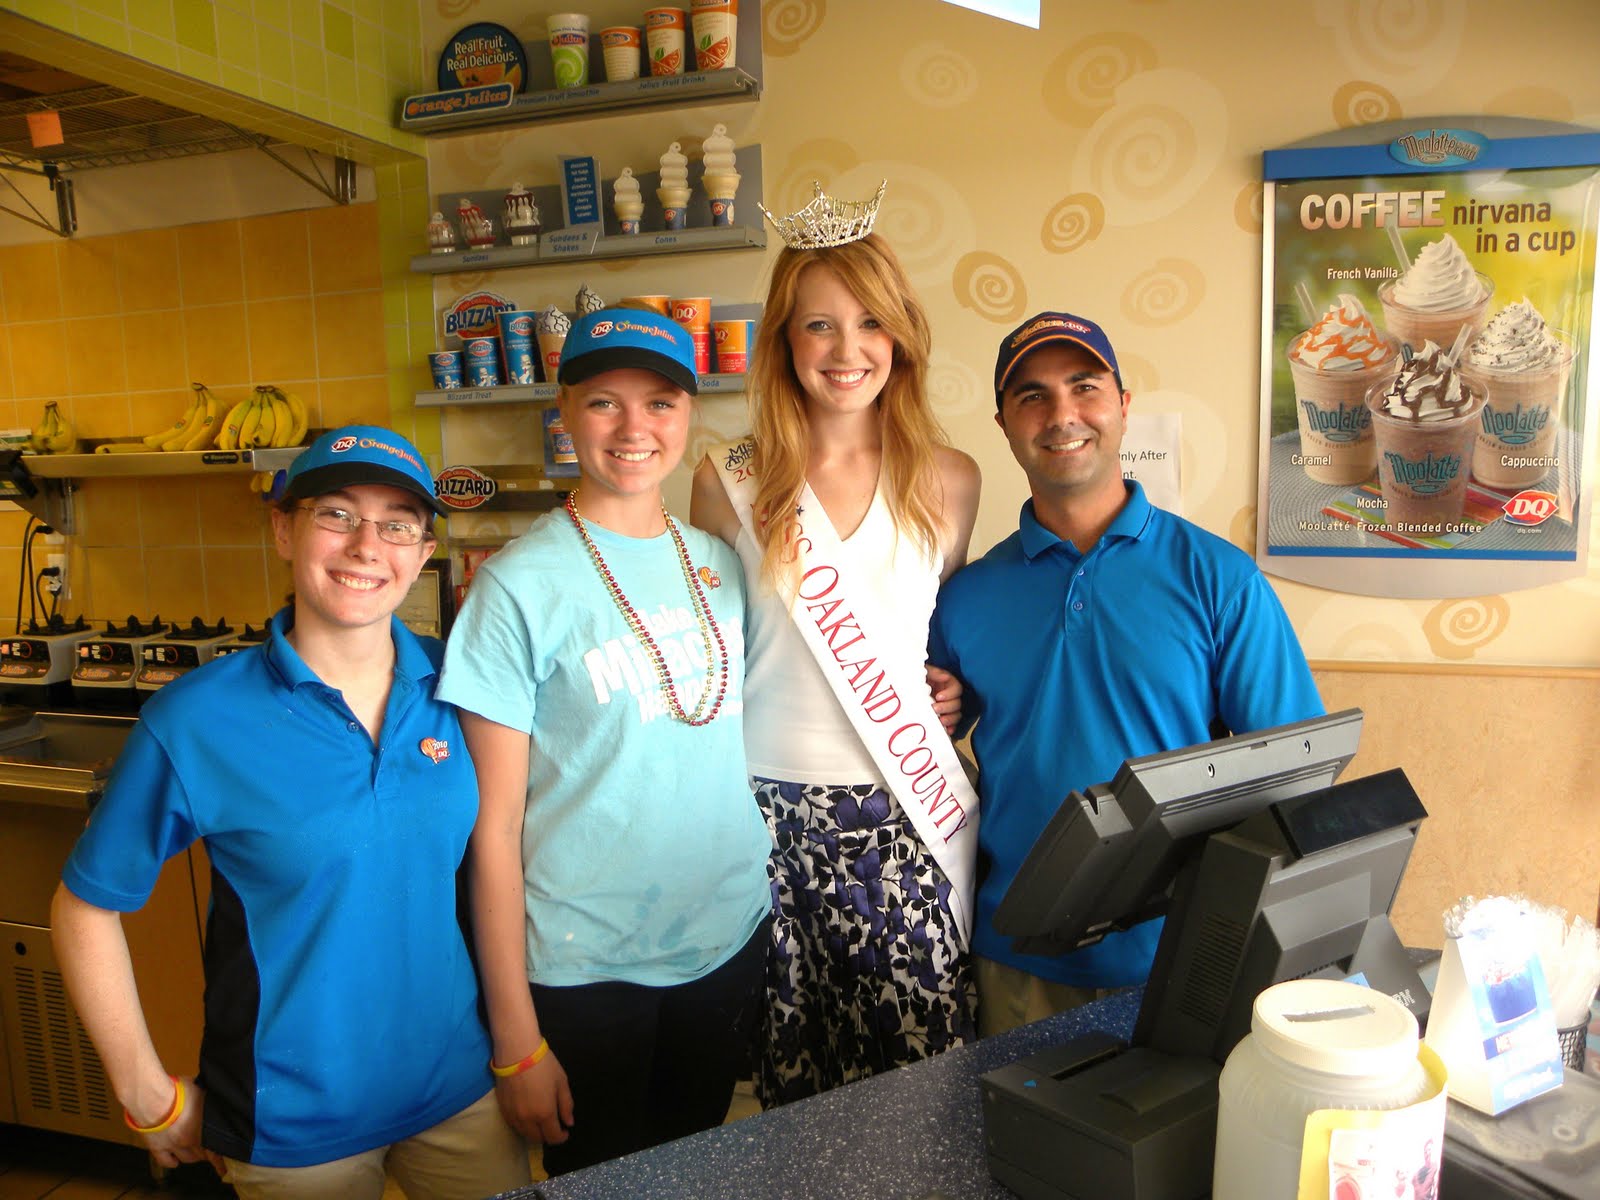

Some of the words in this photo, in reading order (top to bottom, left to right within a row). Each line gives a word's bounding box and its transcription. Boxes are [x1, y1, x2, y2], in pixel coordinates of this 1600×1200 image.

[455, 38, 476, 55] Real
[479, 35, 507, 51] Fruit.
[447, 57, 468, 71] Real
[470, 51, 518, 68] Delicious.
[639, 80, 660, 90] Julius
[662, 78, 679, 87] Fruit
[682, 76, 706, 85] Drinks
[1300, 190, 1446, 231] COFFEE
[1453, 199, 1551, 225] nirvana
[549, 232, 579, 243] Sundaes
[655, 236, 677, 244] Cones
[1476, 228, 1497, 253] in
[1505, 234, 1520, 253] a
[1528, 230, 1576, 256] cup
[553, 244, 579, 253] Shakes
[1327, 268, 1361, 280] French
[1364, 267, 1398, 279] Vanilla
[676, 305, 697, 320] DQ
[595, 324, 611, 334] DQ
[702, 379, 720, 387] Soda
[336, 440, 353, 449] DQ
[1119, 451, 1137, 463] nly
[1140, 450, 1168, 461] After
[1291, 455, 1331, 465] Caramel
[1501, 455, 1560, 468] Cappuccino
[1122, 470, 1137, 480] nt.
[434, 478, 494, 497] BLIZZARD
[1357, 498, 1388, 509] Mocha
[1512, 498, 1549, 518] DQ
[1299, 521, 1350, 531] MooLatté
[1357, 521, 1393, 532] Frozen
[1398, 522, 1441, 533] Blended
[1446, 523, 1482, 533] Coffee
[798, 565, 902, 723] OAKLAND
[888, 722, 968, 844] COUNTY
[433, 741, 448, 750] 2010
[437, 750, 448, 758] DQ
